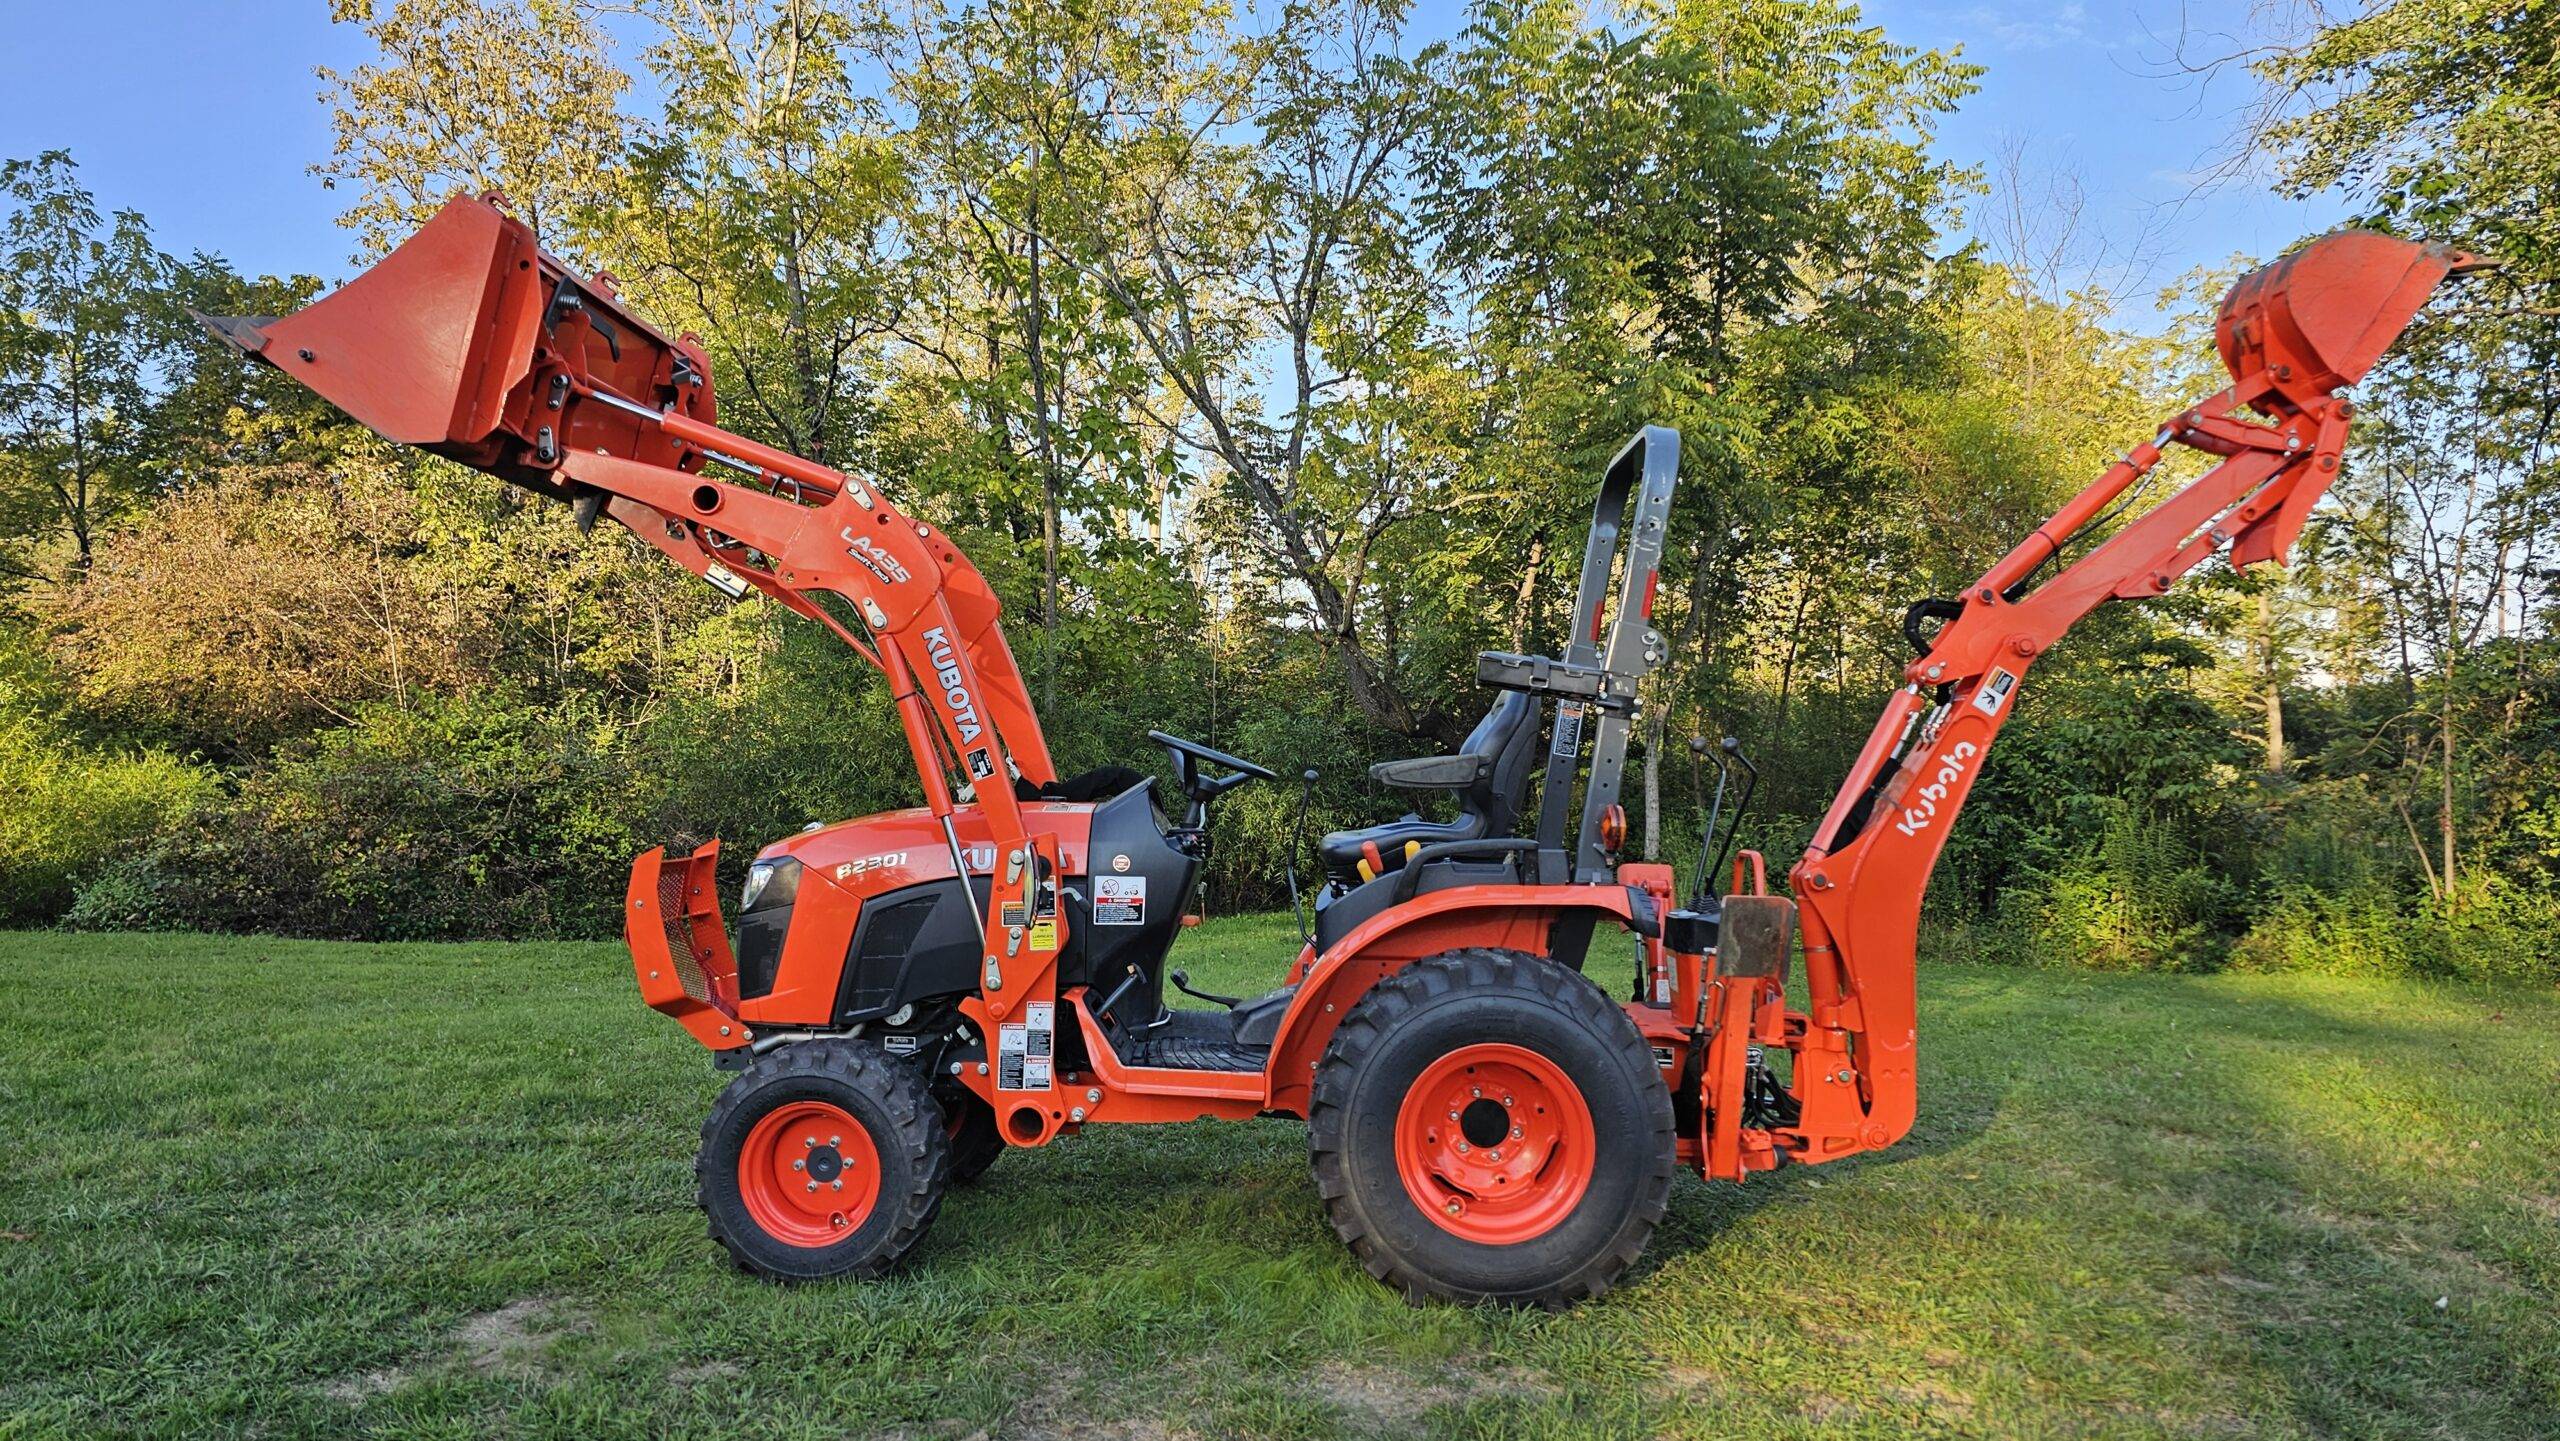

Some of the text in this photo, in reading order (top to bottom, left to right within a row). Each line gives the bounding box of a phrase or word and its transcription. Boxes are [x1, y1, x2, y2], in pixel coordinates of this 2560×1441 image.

[840, 526, 912, 583] LA435
[921, 625, 983, 747] KUBOTA
[1896, 741, 1977, 837] Kubota
[835, 851, 909, 881] B2301
